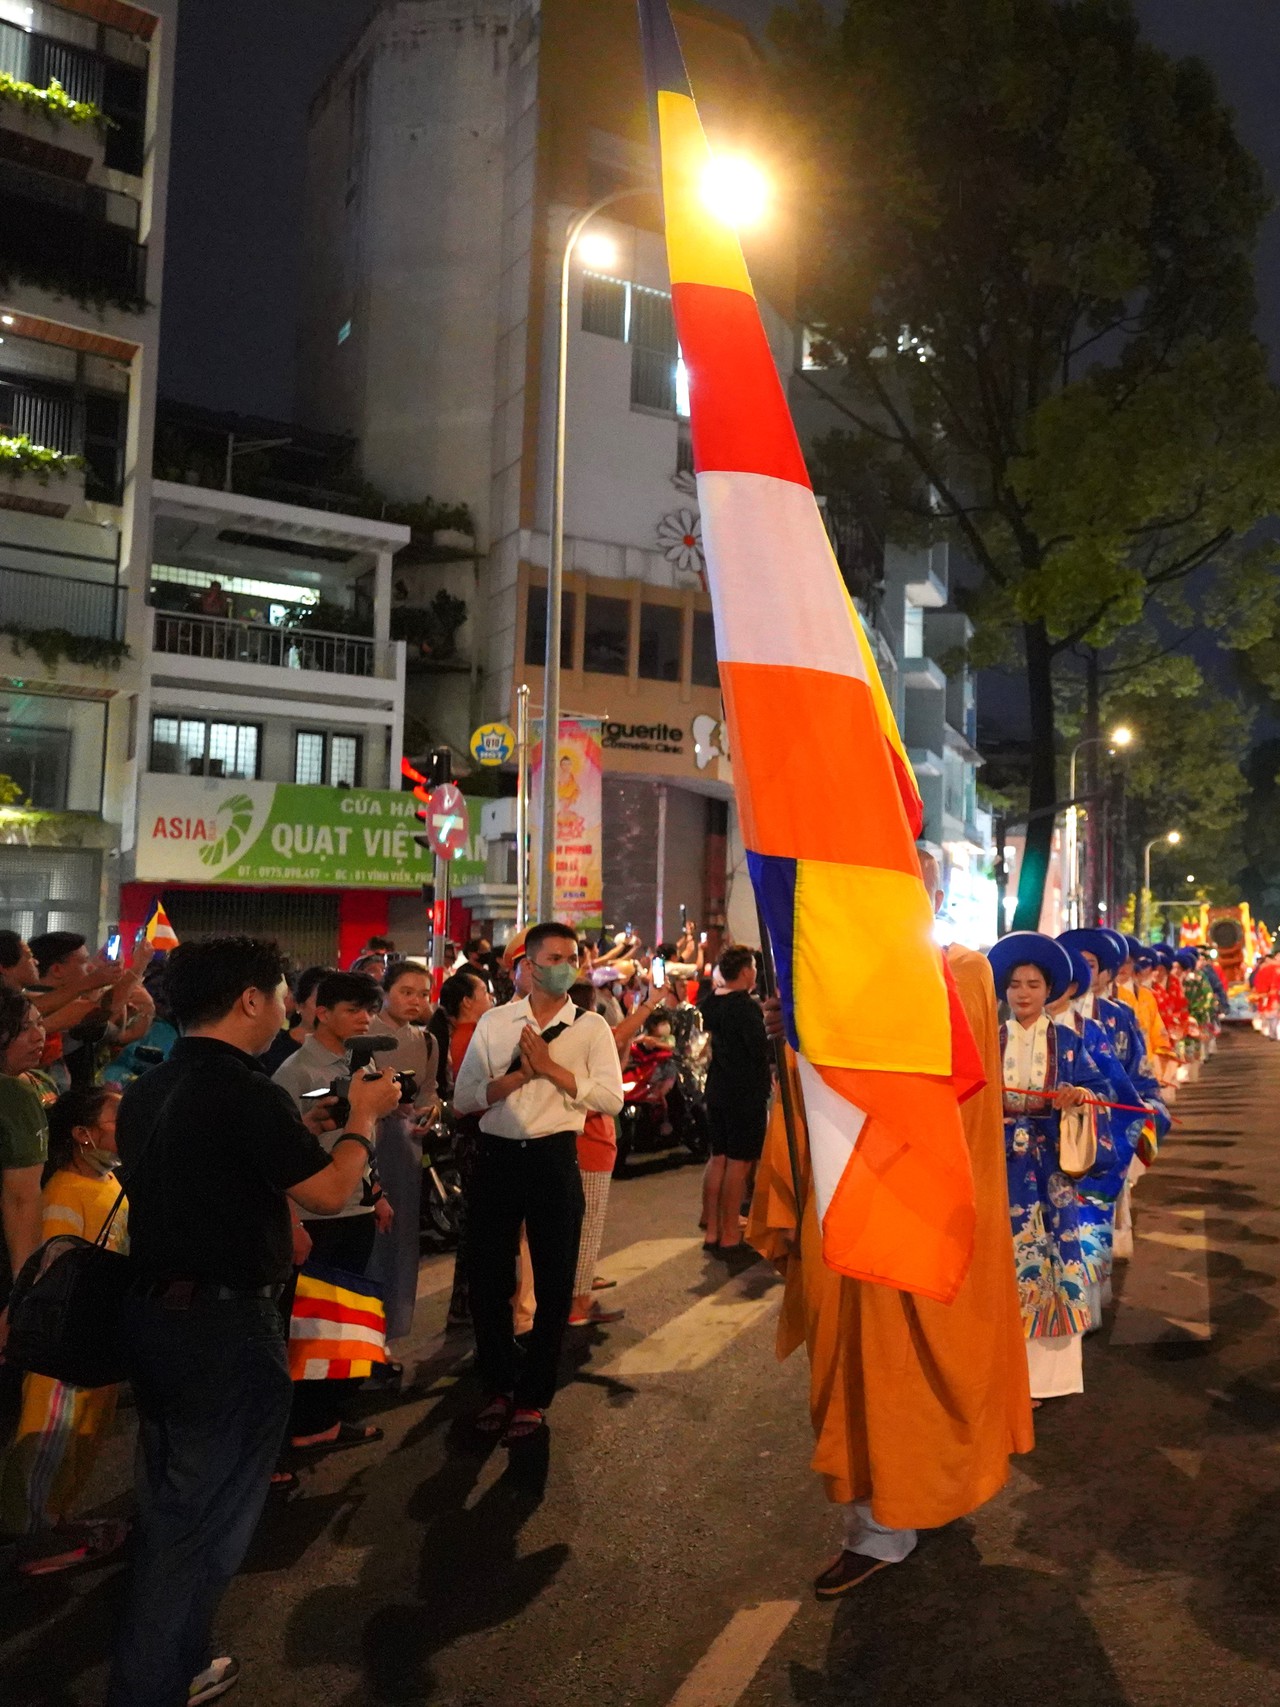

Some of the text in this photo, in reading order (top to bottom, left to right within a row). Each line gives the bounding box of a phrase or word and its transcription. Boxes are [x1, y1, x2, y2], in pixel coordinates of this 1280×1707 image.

[655, 743, 684, 754] Clinic
[340, 794, 382, 815] CỬA
[152, 816, 207, 841] ASIA
[271, 822, 353, 862] QUẠT
